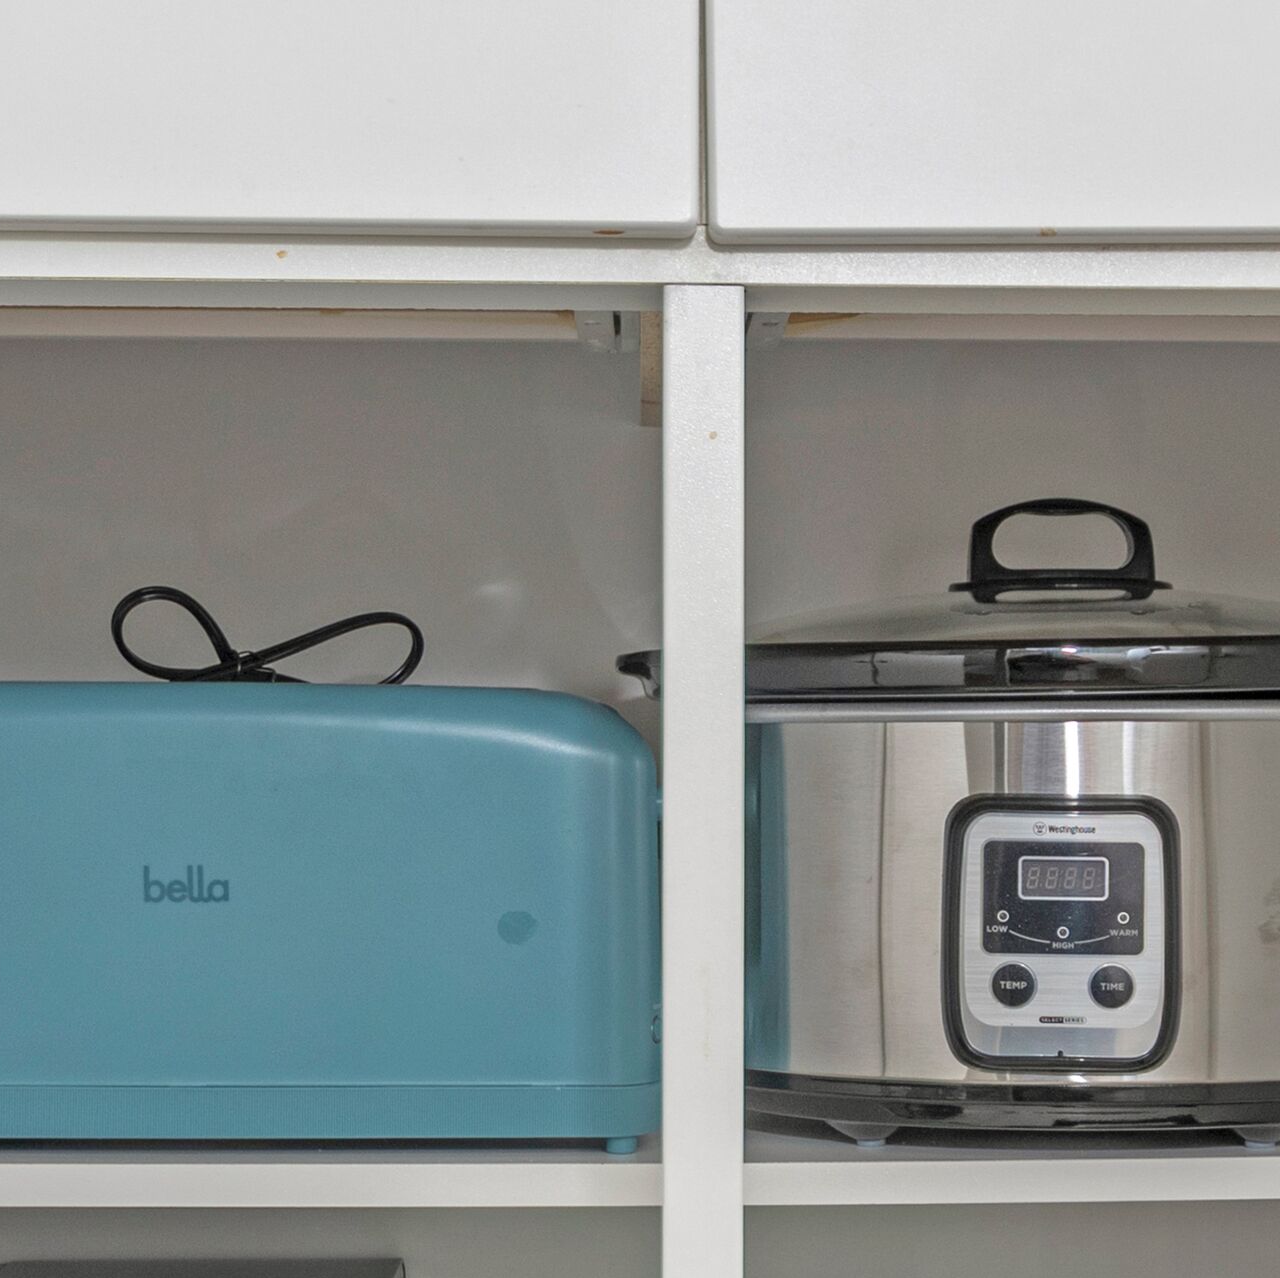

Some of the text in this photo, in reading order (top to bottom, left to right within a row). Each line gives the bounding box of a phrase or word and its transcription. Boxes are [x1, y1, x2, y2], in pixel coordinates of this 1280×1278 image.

[1048, 825, 1096, 835] Westinghouse
[143, 865, 230, 903] bella
[986, 925, 1008, 933] LOW
[1052, 941, 1075, 949] HIGH
[999, 981, 1028, 990] TEMP
[1099, 983, 1125, 991] TIME
